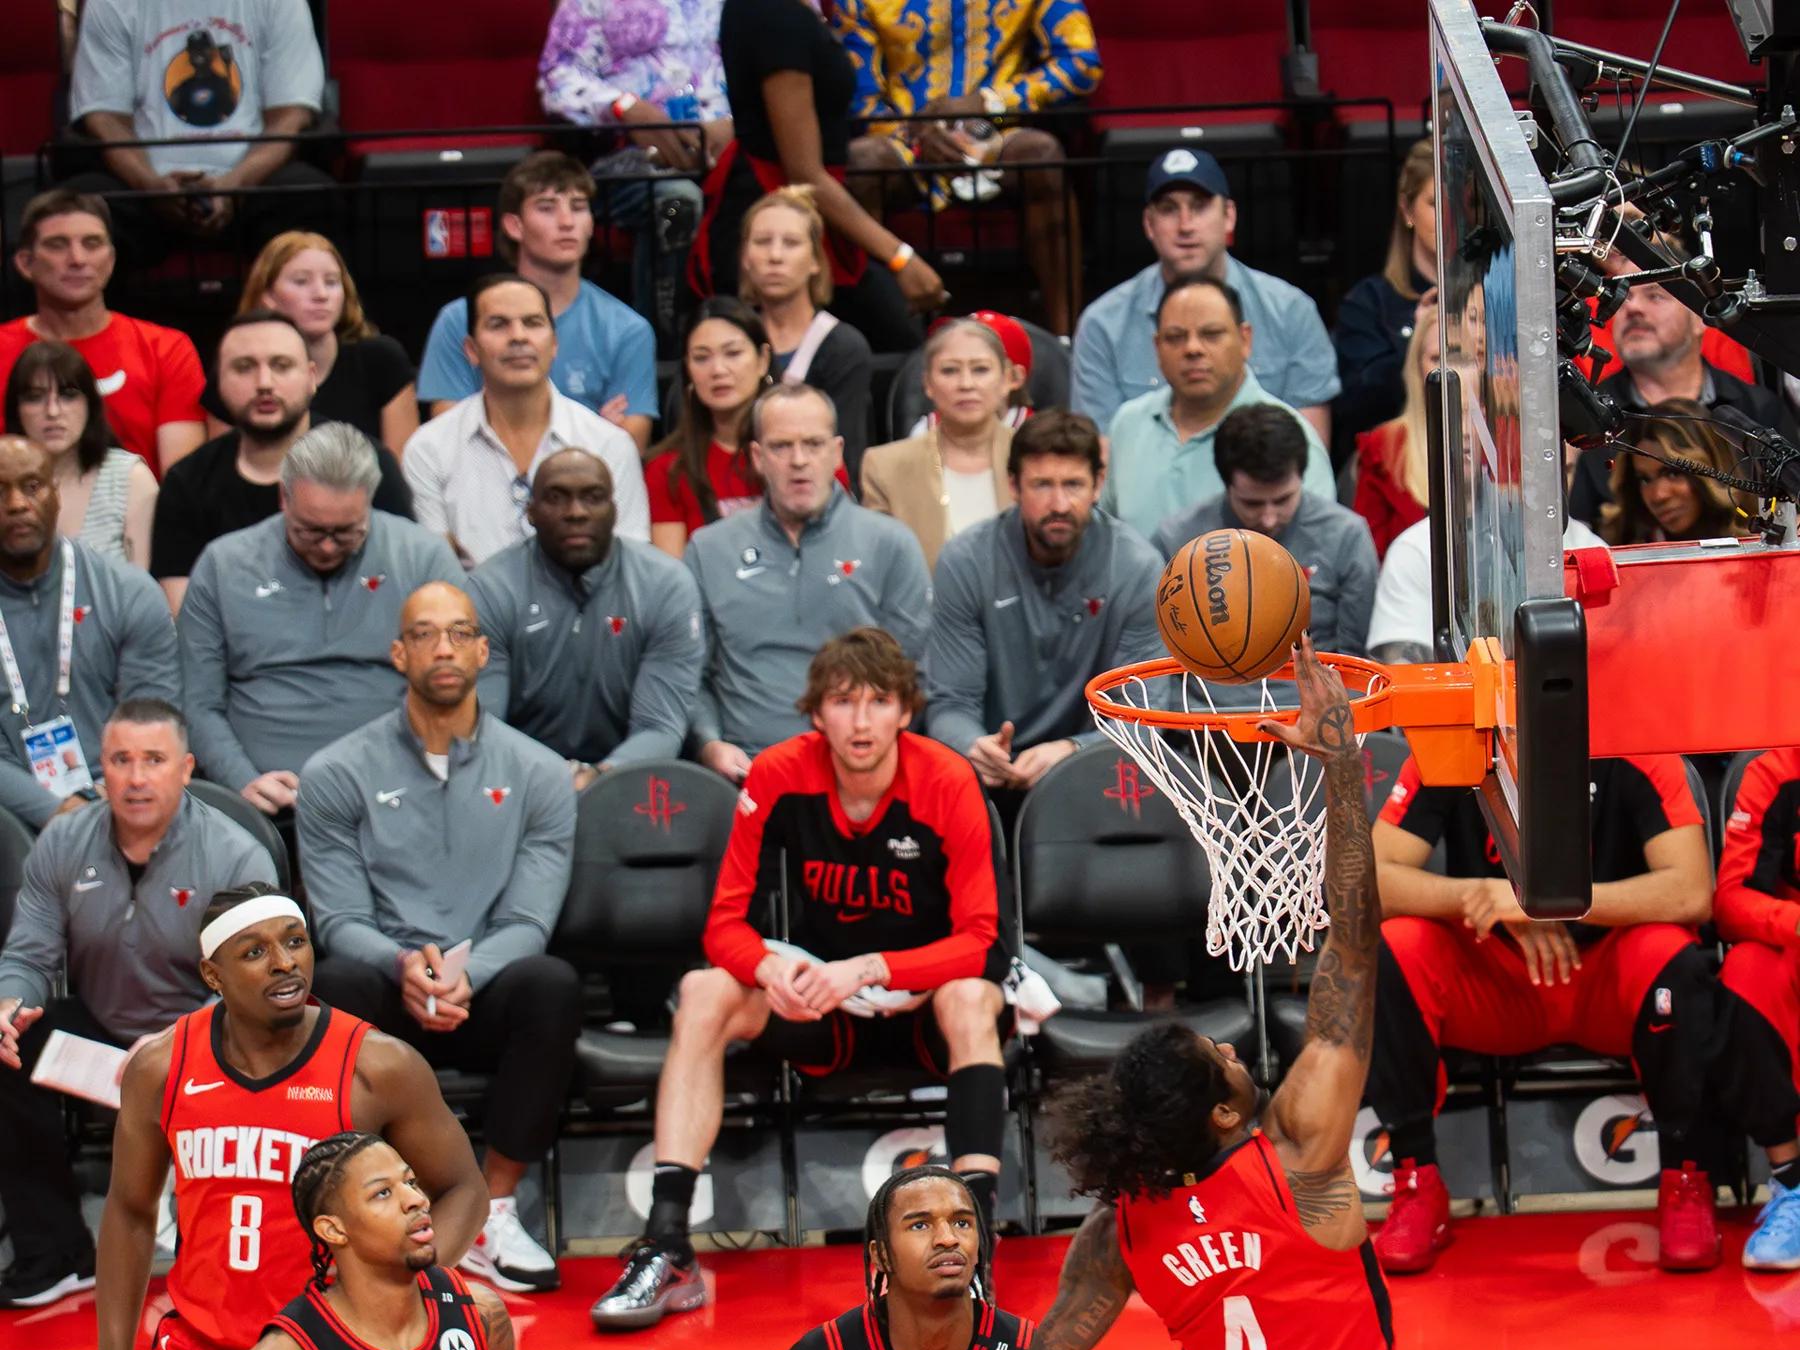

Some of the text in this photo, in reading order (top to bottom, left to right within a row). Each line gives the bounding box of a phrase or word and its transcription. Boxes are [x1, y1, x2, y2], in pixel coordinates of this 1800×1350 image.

[1205, 533, 1232, 626] Wilson
[176, 1126, 321, 1185] ROCKET
[229, 1195, 263, 1271] 8
[1162, 1231, 1261, 1287] GREEN
[442, 1292, 453, 1303] 10
